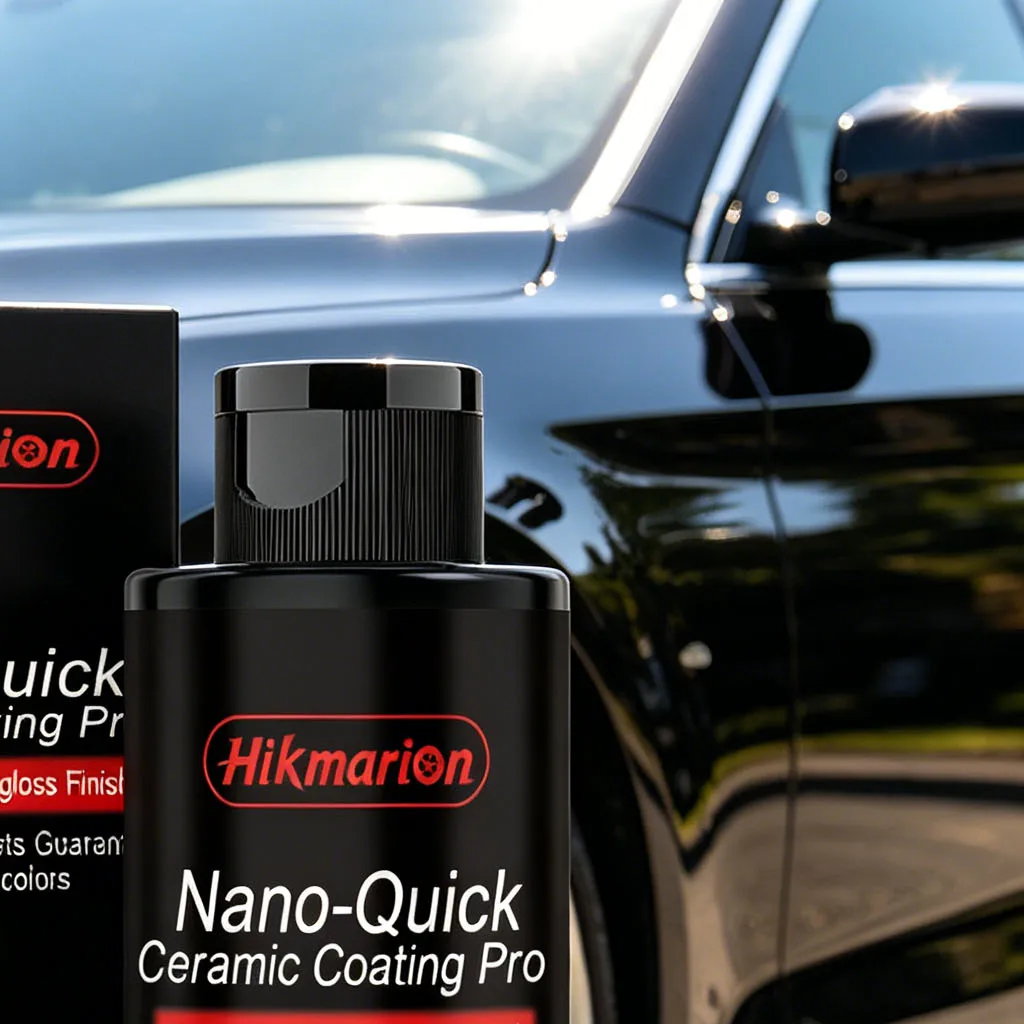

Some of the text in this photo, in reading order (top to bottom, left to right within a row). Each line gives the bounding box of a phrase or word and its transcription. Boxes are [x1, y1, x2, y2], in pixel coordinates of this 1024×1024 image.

[79, 705, 124, 738] Pr
[216, 733, 476, 791] Hikmarion
[34, 829, 124, 857] Guaran
[1, 864, 71, 892] colors
[175, 868, 523, 937] Nano-Quick
[138, 939, 546, 998] Ceramic Coating Pro
